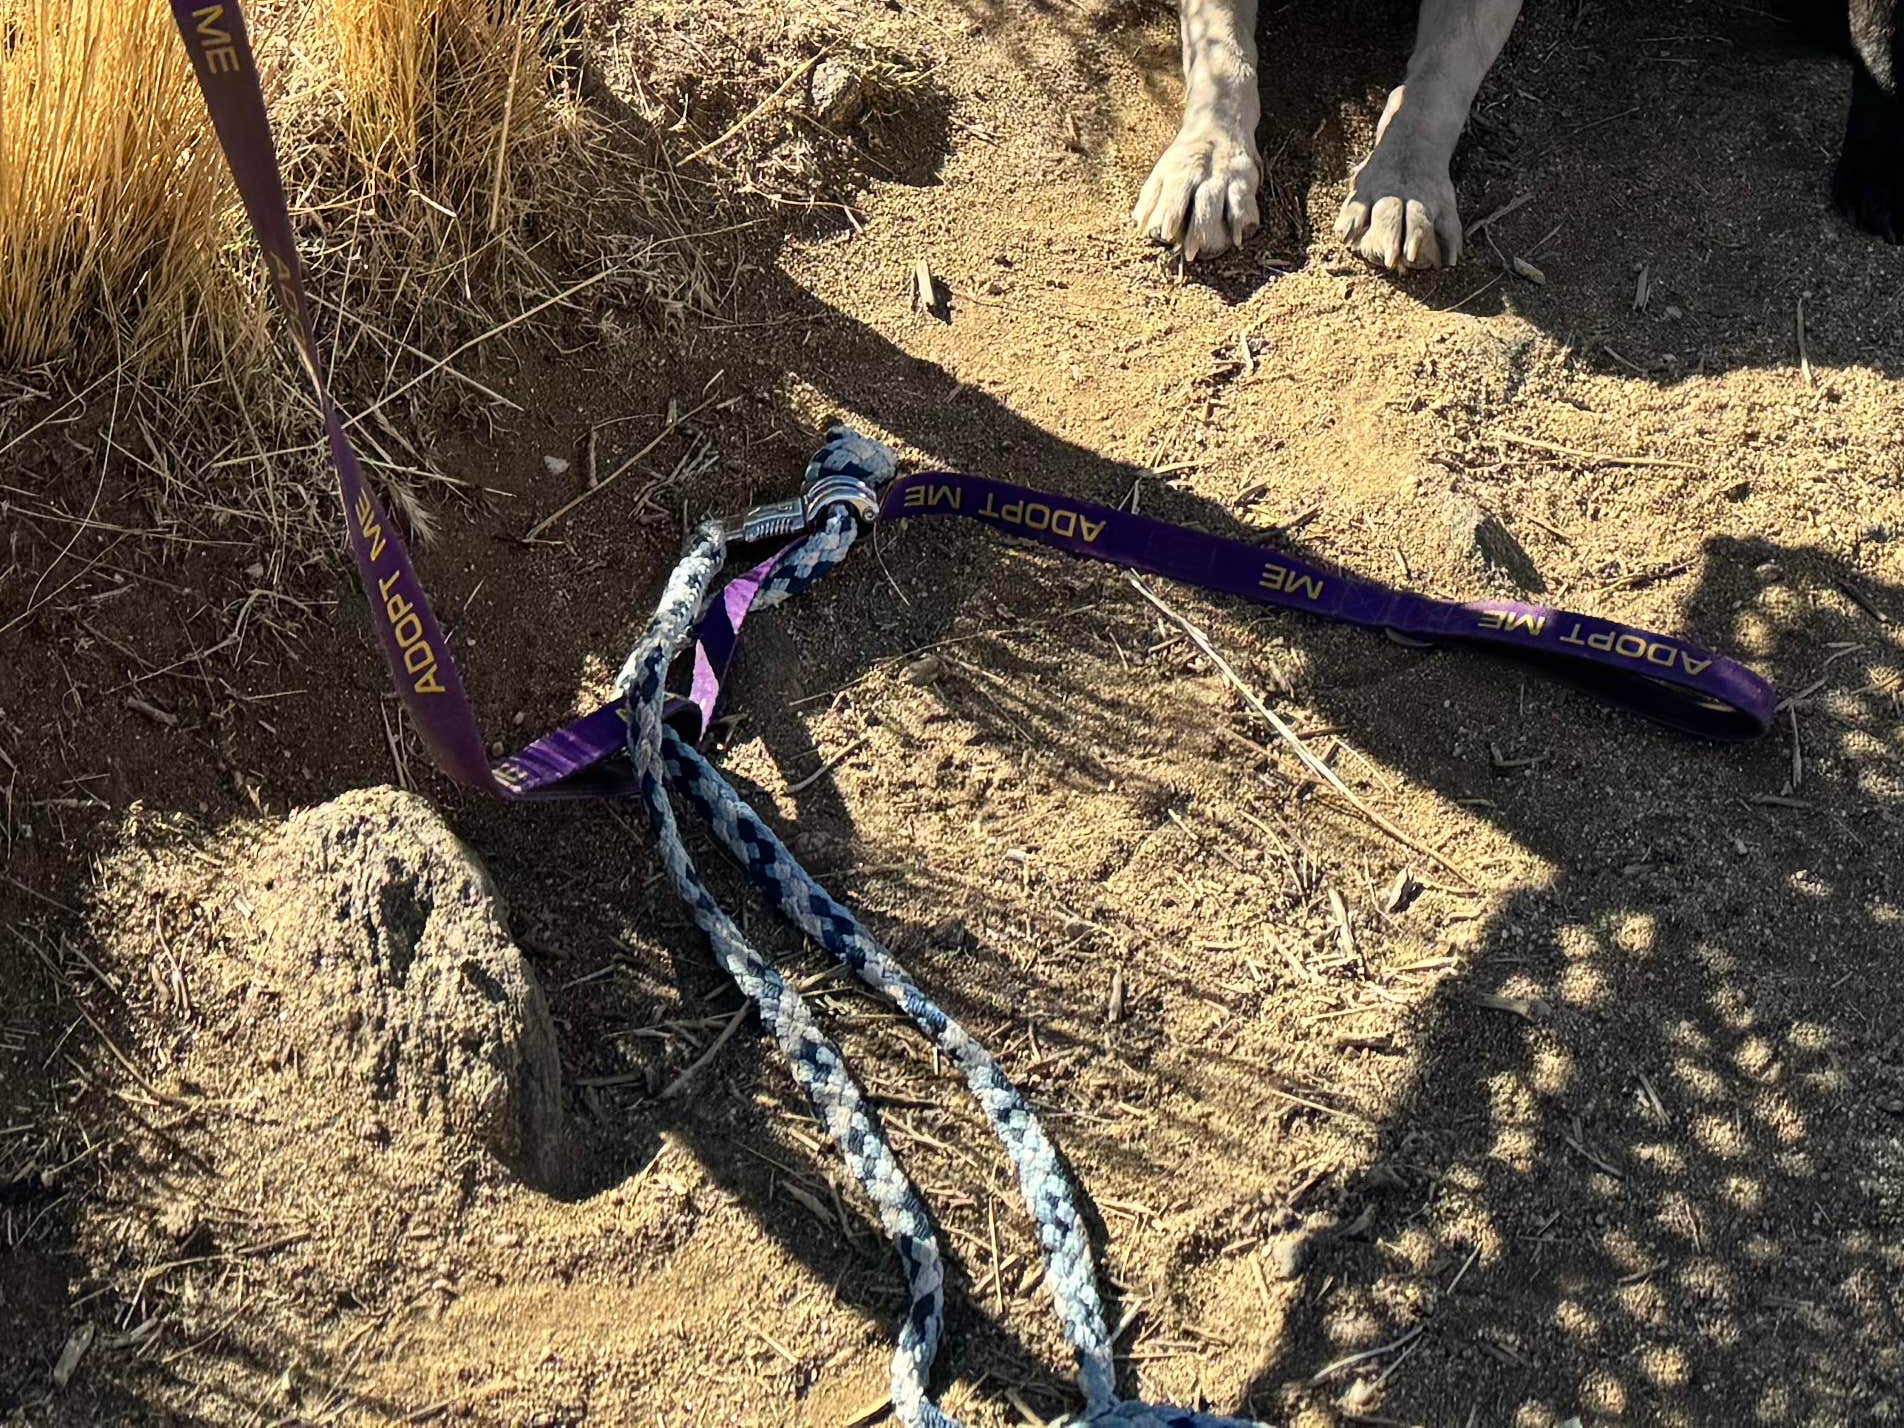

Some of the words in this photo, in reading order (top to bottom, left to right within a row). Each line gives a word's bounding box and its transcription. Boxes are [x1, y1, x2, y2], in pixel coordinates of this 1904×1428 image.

[192, 4, 240, 75] ME
[904, 485, 961, 510] ME
[978, 492, 1108, 542] ADOPT
[355, 490, 387, 562] ME
[1259, 562, 1324, 600] ME
[378, 569, 446, 695] ADOPT
[1478, 610, 1548, 636] ME
[1560, 623, 1712, 676] ADOPT
